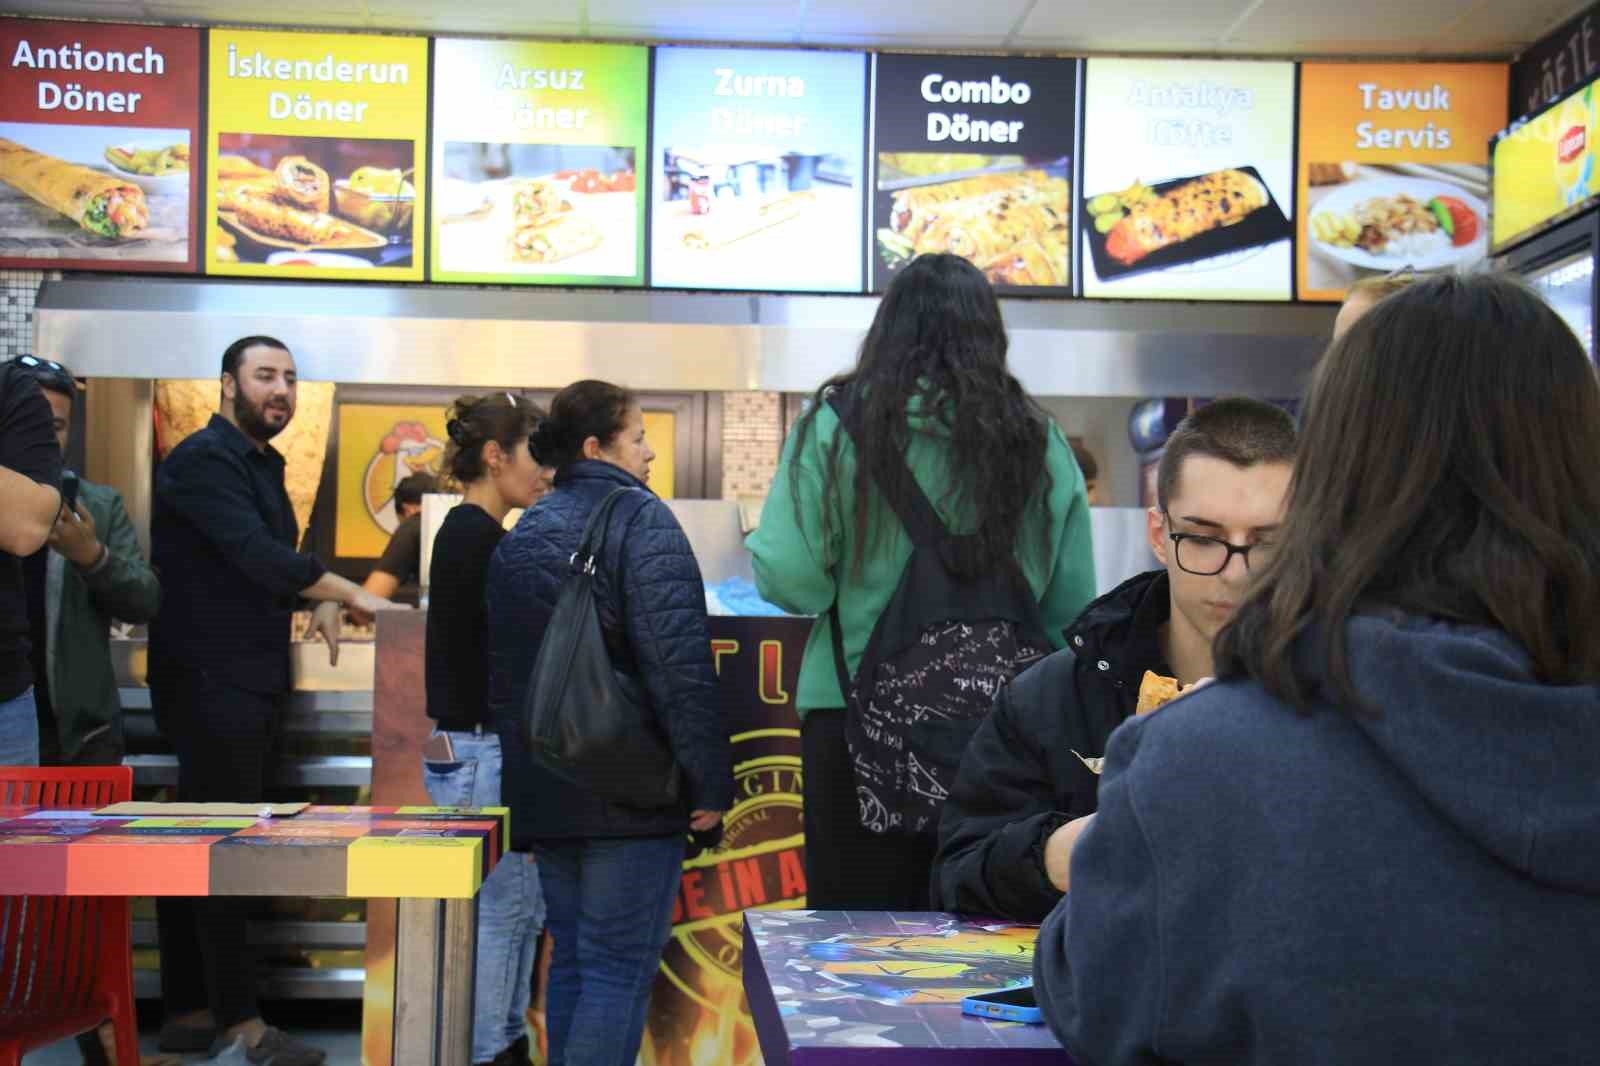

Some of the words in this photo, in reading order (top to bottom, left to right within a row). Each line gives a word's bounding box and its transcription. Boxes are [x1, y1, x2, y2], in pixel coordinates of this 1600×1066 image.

[12, 40, 166, 74] Antionch
[226, 42, 411, 84] İskenderun
[496, 63, 585, 92] Arsuz
[711, 66, 807, 98] Zurna
[920, 73, 1032, 105] Combo
[37, 82, 142, 113] Döner
[267, 91, 370, 124] Döner
[1357, 82, 1452, 113] Tavuk
[926, 112, 1025, 143] Döner
[1354, 120, 1452, 149] Servis
